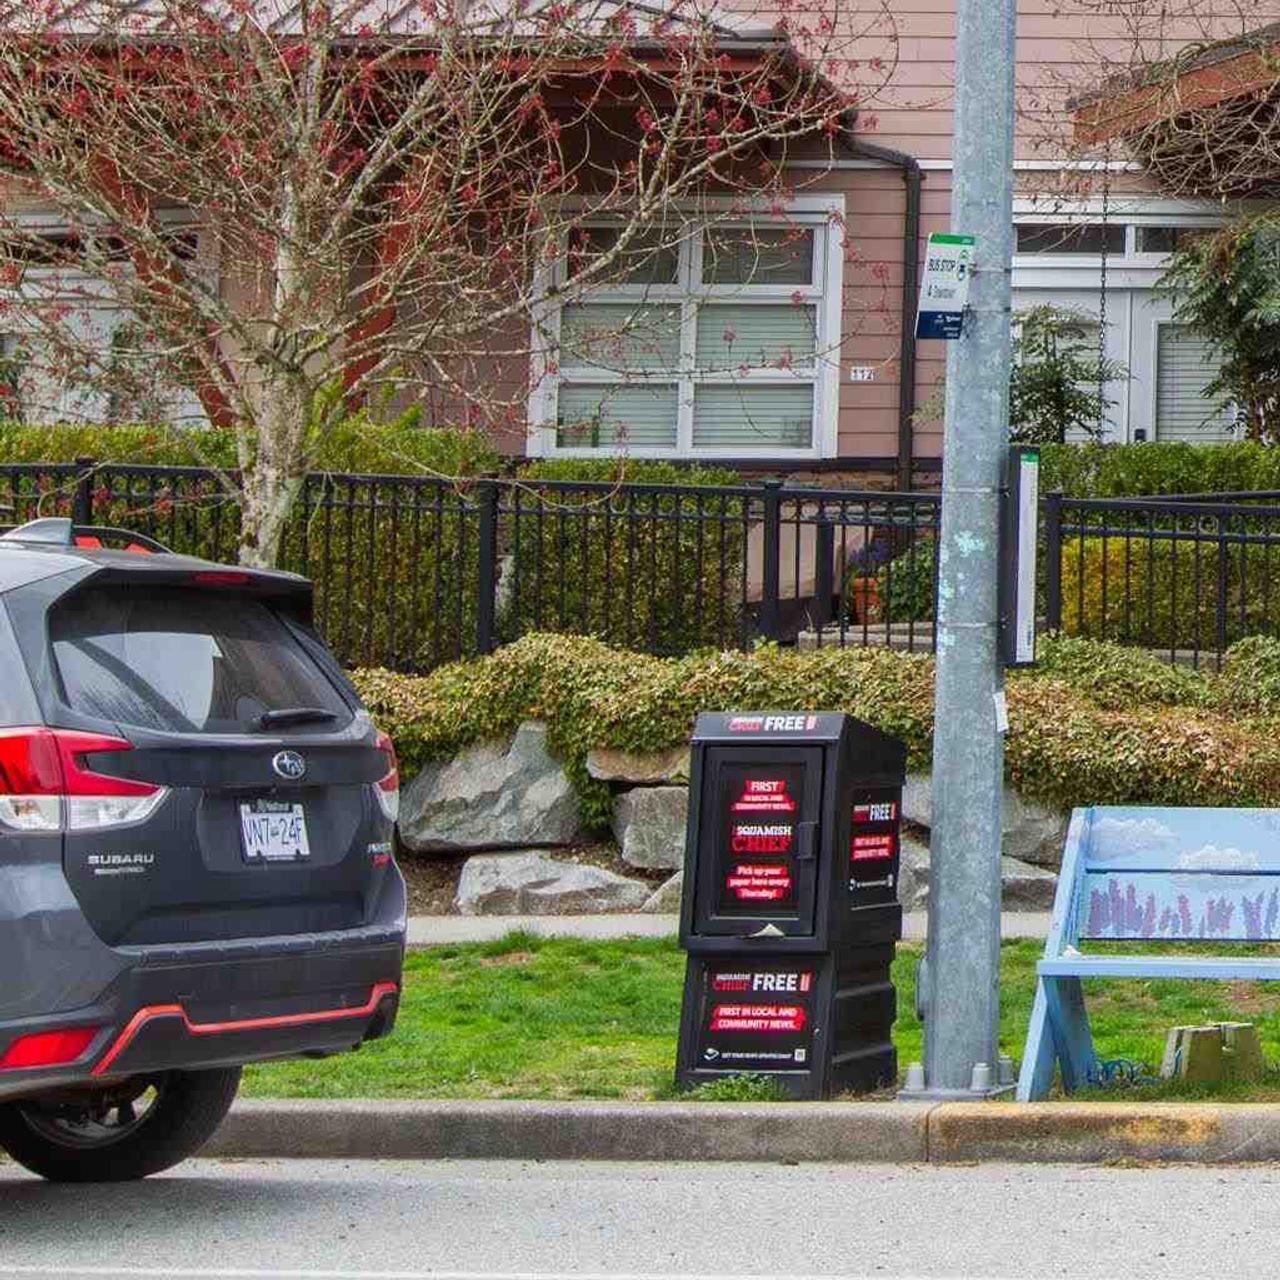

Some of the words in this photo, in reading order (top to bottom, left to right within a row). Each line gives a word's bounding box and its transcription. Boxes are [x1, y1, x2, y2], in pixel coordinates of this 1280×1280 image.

[764, 715, 805, 731] FREE
[751, 781, 779, 792] FIRST
[88, 854, 154, 865] SUBARU
[752, 973, 798, 991] FREE
